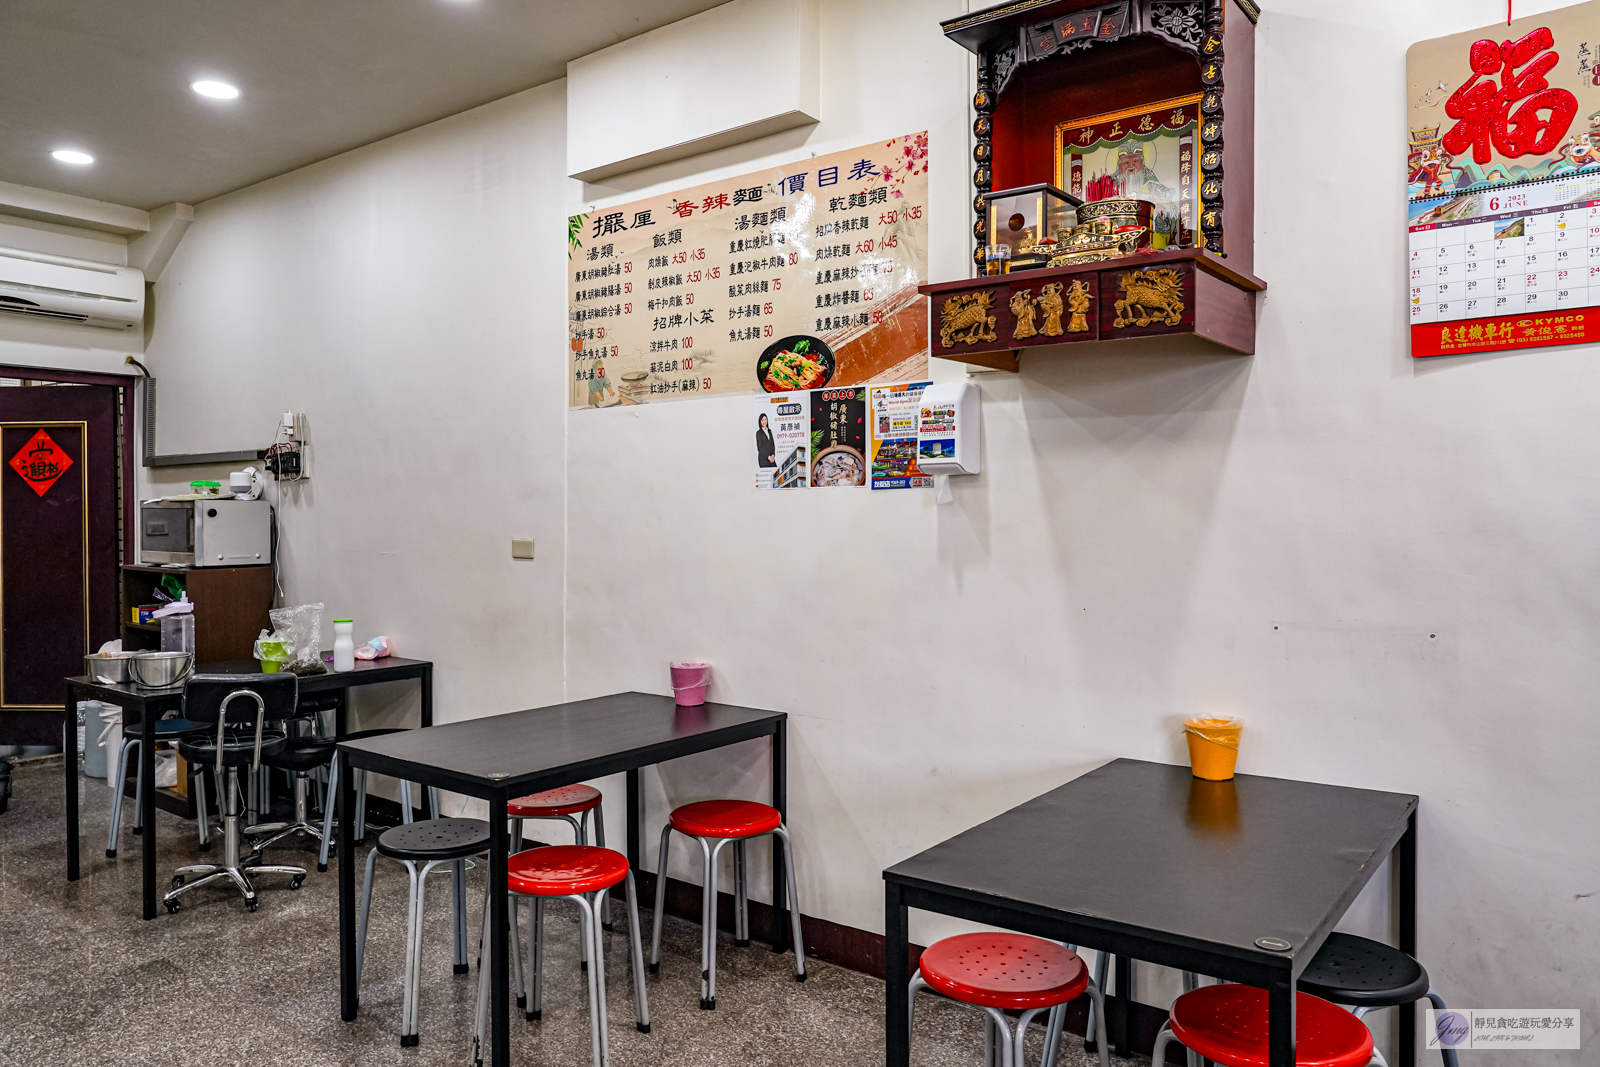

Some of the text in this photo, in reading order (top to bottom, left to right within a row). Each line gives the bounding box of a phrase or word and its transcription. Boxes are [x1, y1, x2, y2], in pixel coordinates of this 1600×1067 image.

[1441, 27, 1578, 165] 福
[1079, 108, 1184, 144] 福德正神
[672, 186, 764, 218] 香辣麵
[778, 159, 880, 196] 價目表
[829, 187, 887, 213] 乾麵類
[1489, 196, 1528, 211] 6 JUNE
[735, 207, 787, 231] 湯麵類
[878, 210, 898, 225] 大50
[902, 206, 922, 221] 小35
[652, 229, 682, 248] 飯類
[855, 239, 874, 254] 大60
[878, 235, 898, 250] 小45
[586, 243, 614, 261] 湯類
[672, 251, 688, 264] 大50
[690, 248, 706, 261] 小35
[788, 252, 798, 265] 80
[624, 261, 633, 273] 50
[686, 270, 702, 283] 大50
[705, 267, 720, 280] 小35
[624, 282, 633, 294] 50
[772, 278, 782, 291] 75
[685, 293, 695, 305] 50
[863, 287, 874, 301] 65
[624, 302, 633, 314] 50
[729, 302, 773, 320] 抄手湯麵 65
[652, 309, 714, 331] 招牌小菜
[872, 311, 883, 324] 50
[1535, 314, 1584, 326] KYMCO
[597, 327, 605, 338] 50
[729, 325, 773, 342] 魚丸湯麵 50
[1440, 322, 1515, 345] 良達機車行
[681, 336, 693, 349] 100
[610, 345, 619, 357] 50
[681, 358, 693, 370] 100
[597, 367, 605, 378] 30
[703, 377, 712, 390] 50
[839, 404, 848, 424] 廣東
